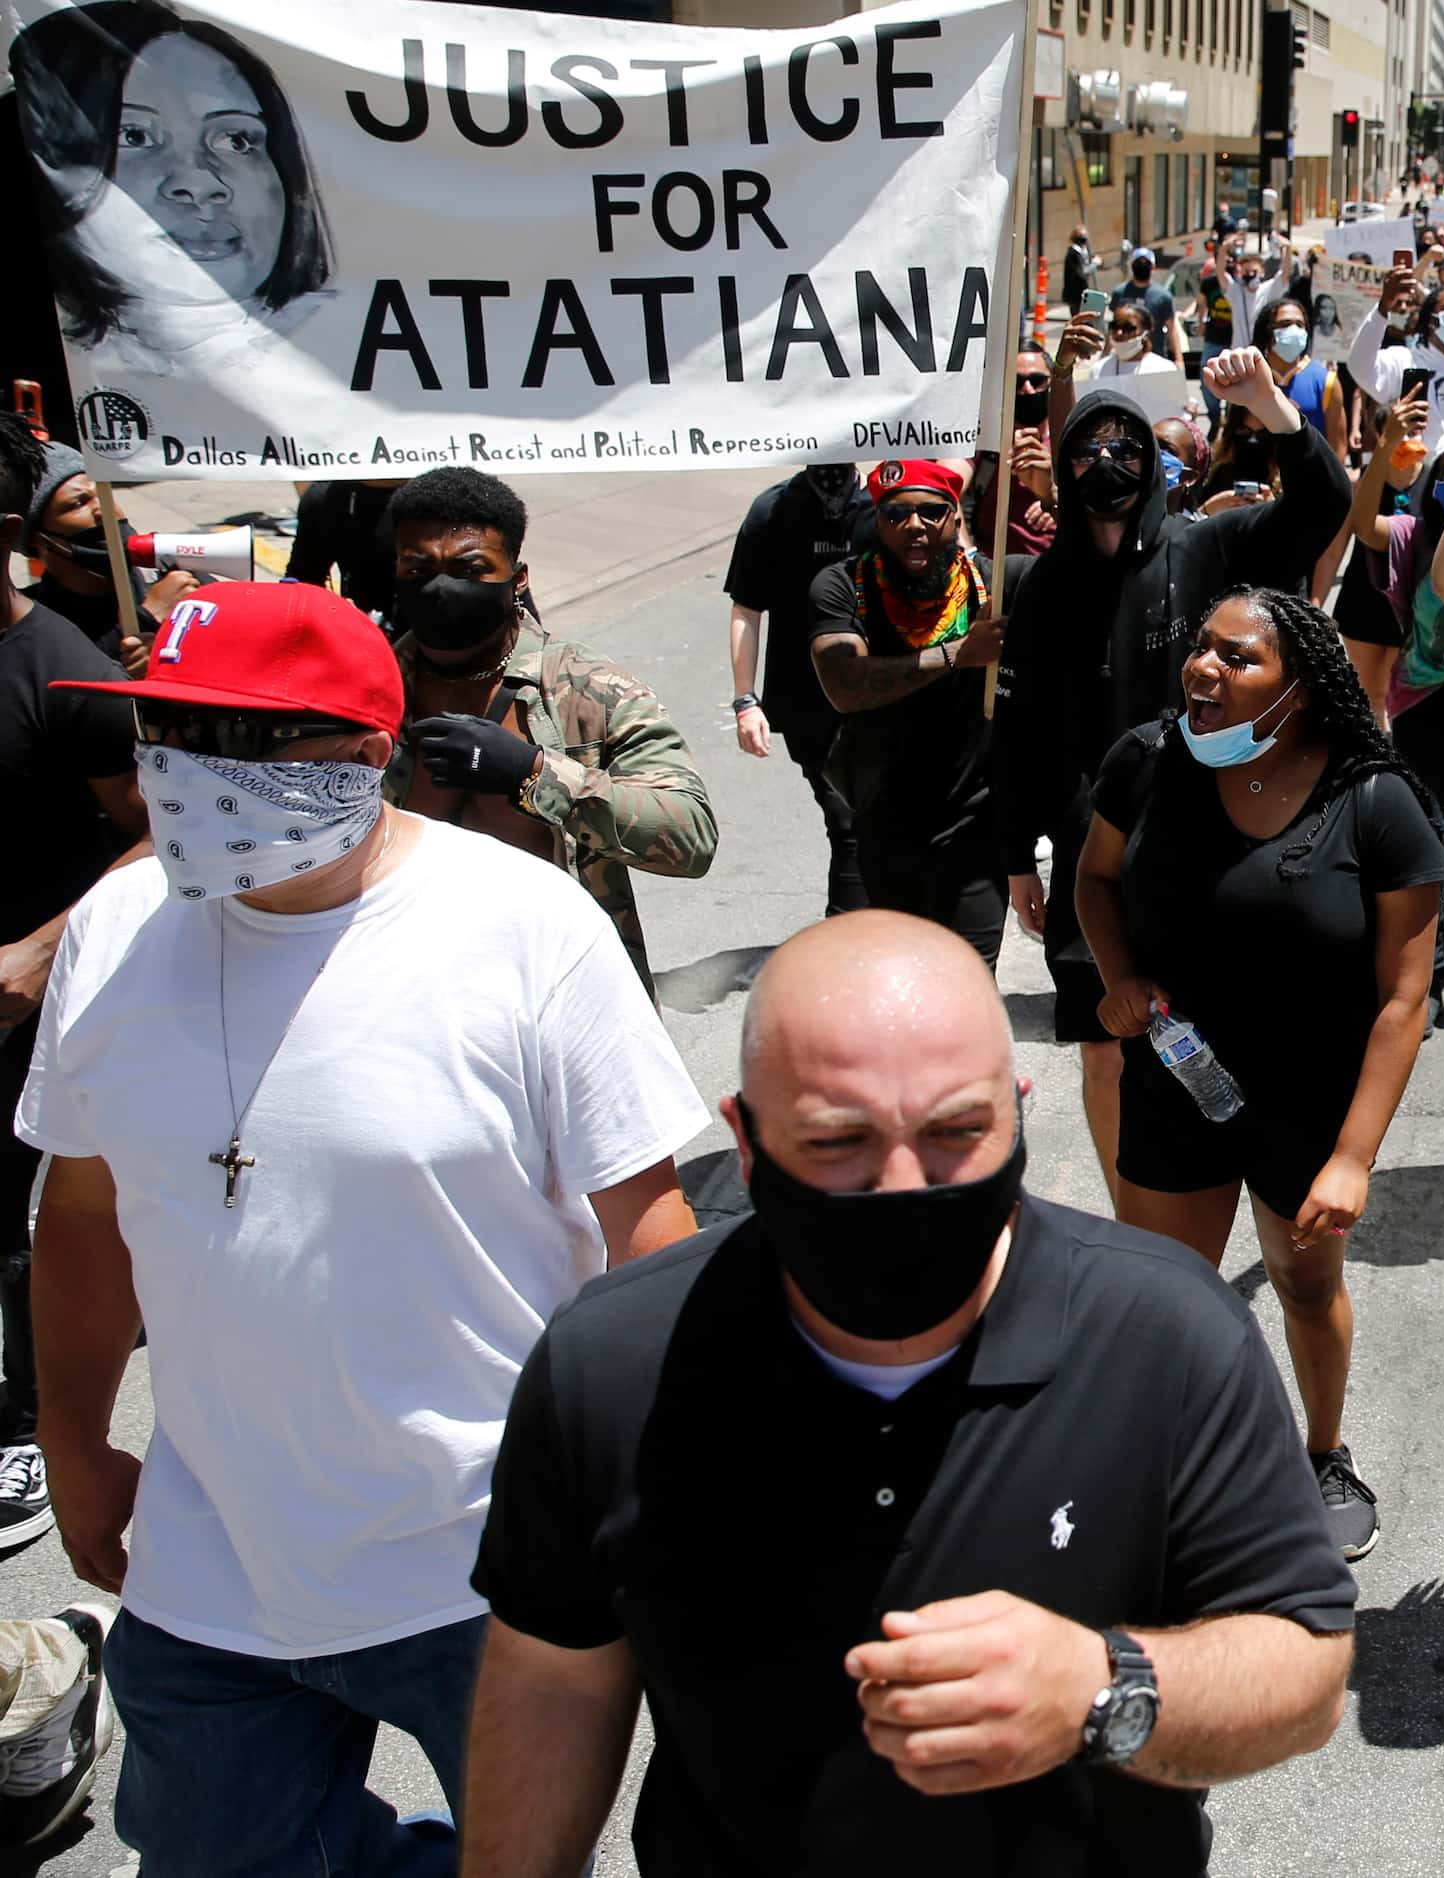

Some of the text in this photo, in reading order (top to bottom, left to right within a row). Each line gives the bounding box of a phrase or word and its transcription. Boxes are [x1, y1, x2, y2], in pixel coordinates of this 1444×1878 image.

[345, 20, 946, 150] JUSTICE
[592, 169, 788, 254] FOR
[350, 266, 988, 392] ATATIANA
[162, 427, 818, 467] Dallas Alliance Against Racist and Political Repression
[176, 545, 206, 555] PYLE
[159, 599, 219, 664] T
